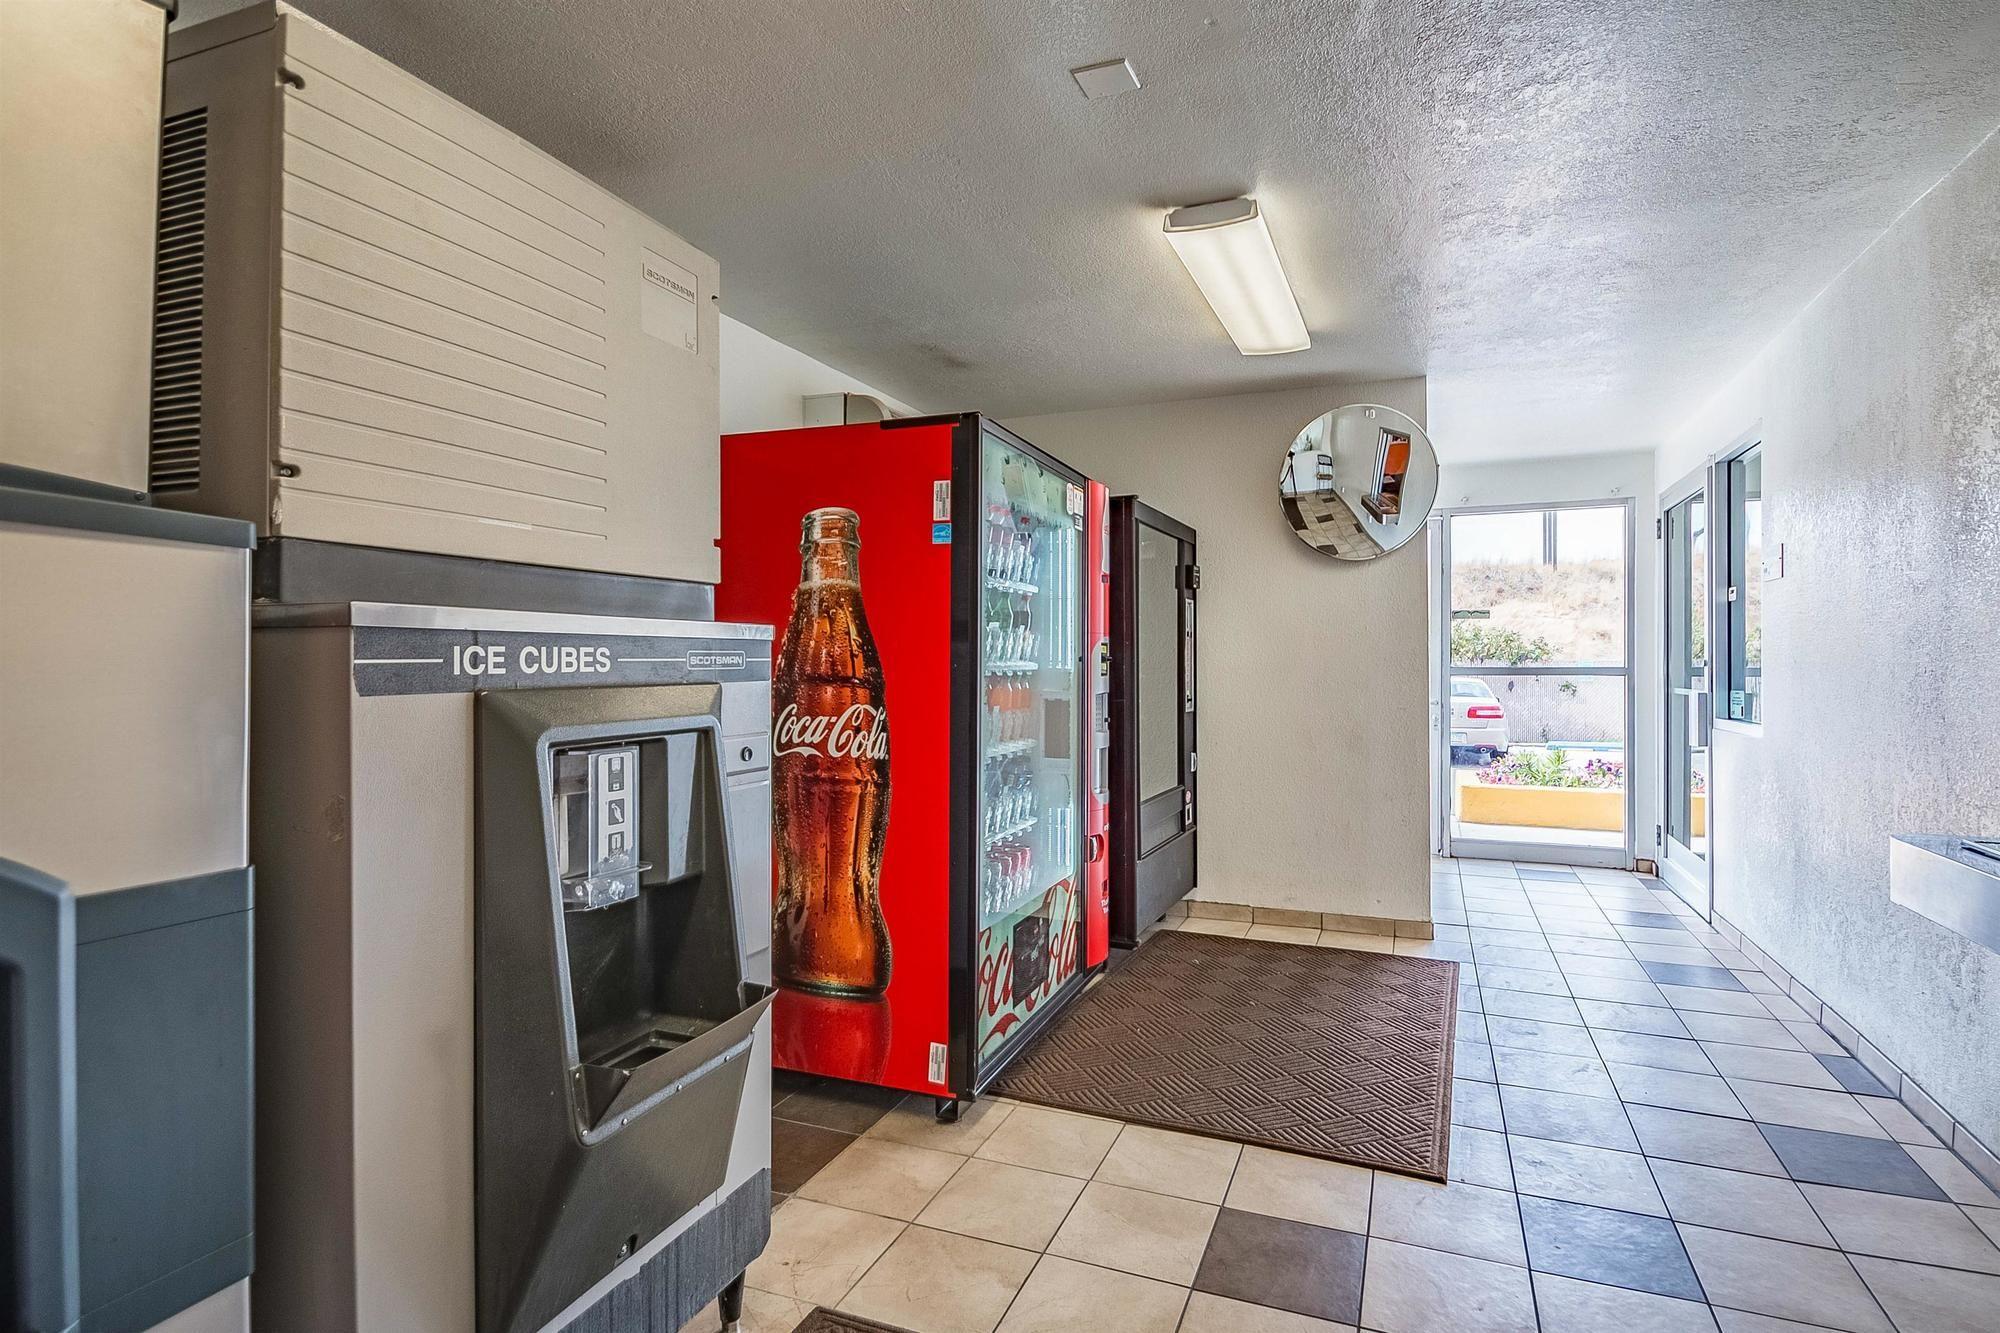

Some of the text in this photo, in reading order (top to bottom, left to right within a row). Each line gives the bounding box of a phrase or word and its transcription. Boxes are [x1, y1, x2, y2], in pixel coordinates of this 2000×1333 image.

[646, 267, 696, 302] SCOTSMAN
[453, 645, 611, 676] ICE CUBES
[690, 655, 743, 666] SCOTSMAN
[773, 703, 889, 759] Coca-Cola
